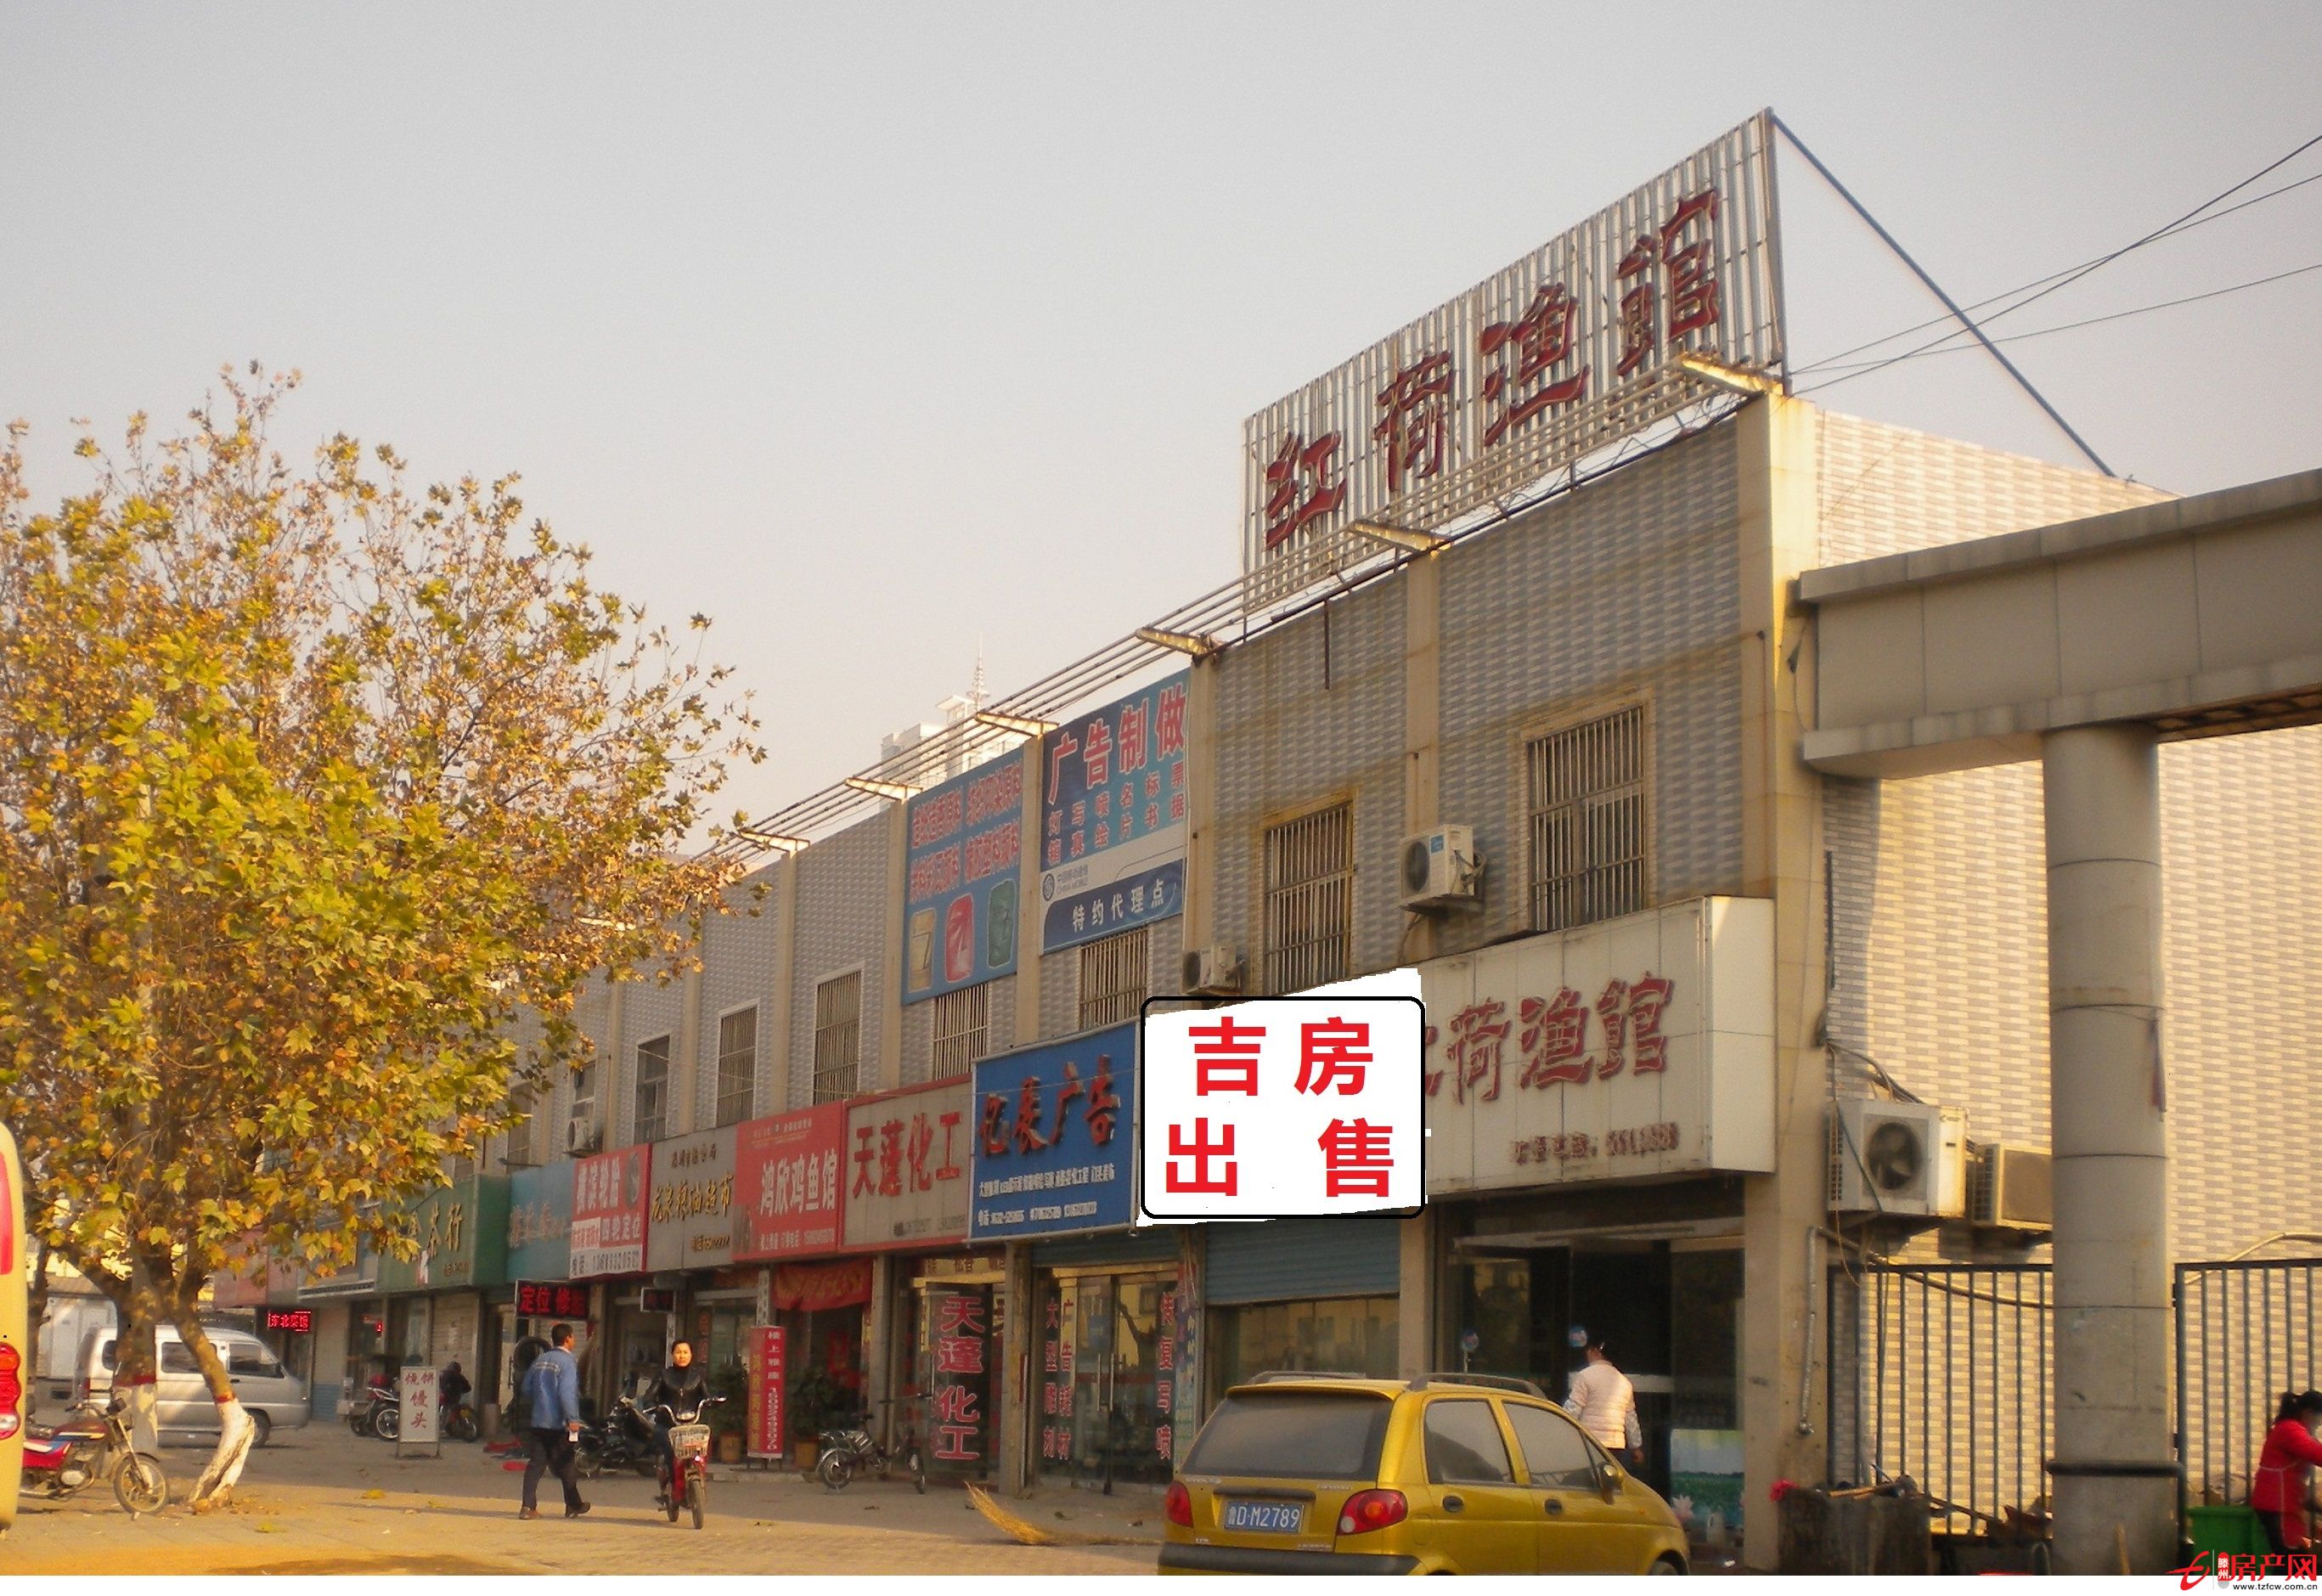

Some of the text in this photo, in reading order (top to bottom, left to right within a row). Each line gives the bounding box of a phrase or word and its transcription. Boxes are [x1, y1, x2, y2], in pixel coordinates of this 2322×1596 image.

[1048, 683, 1186, 805] 广告制做
[1072, 878, 1164, 933] 特约代理点
